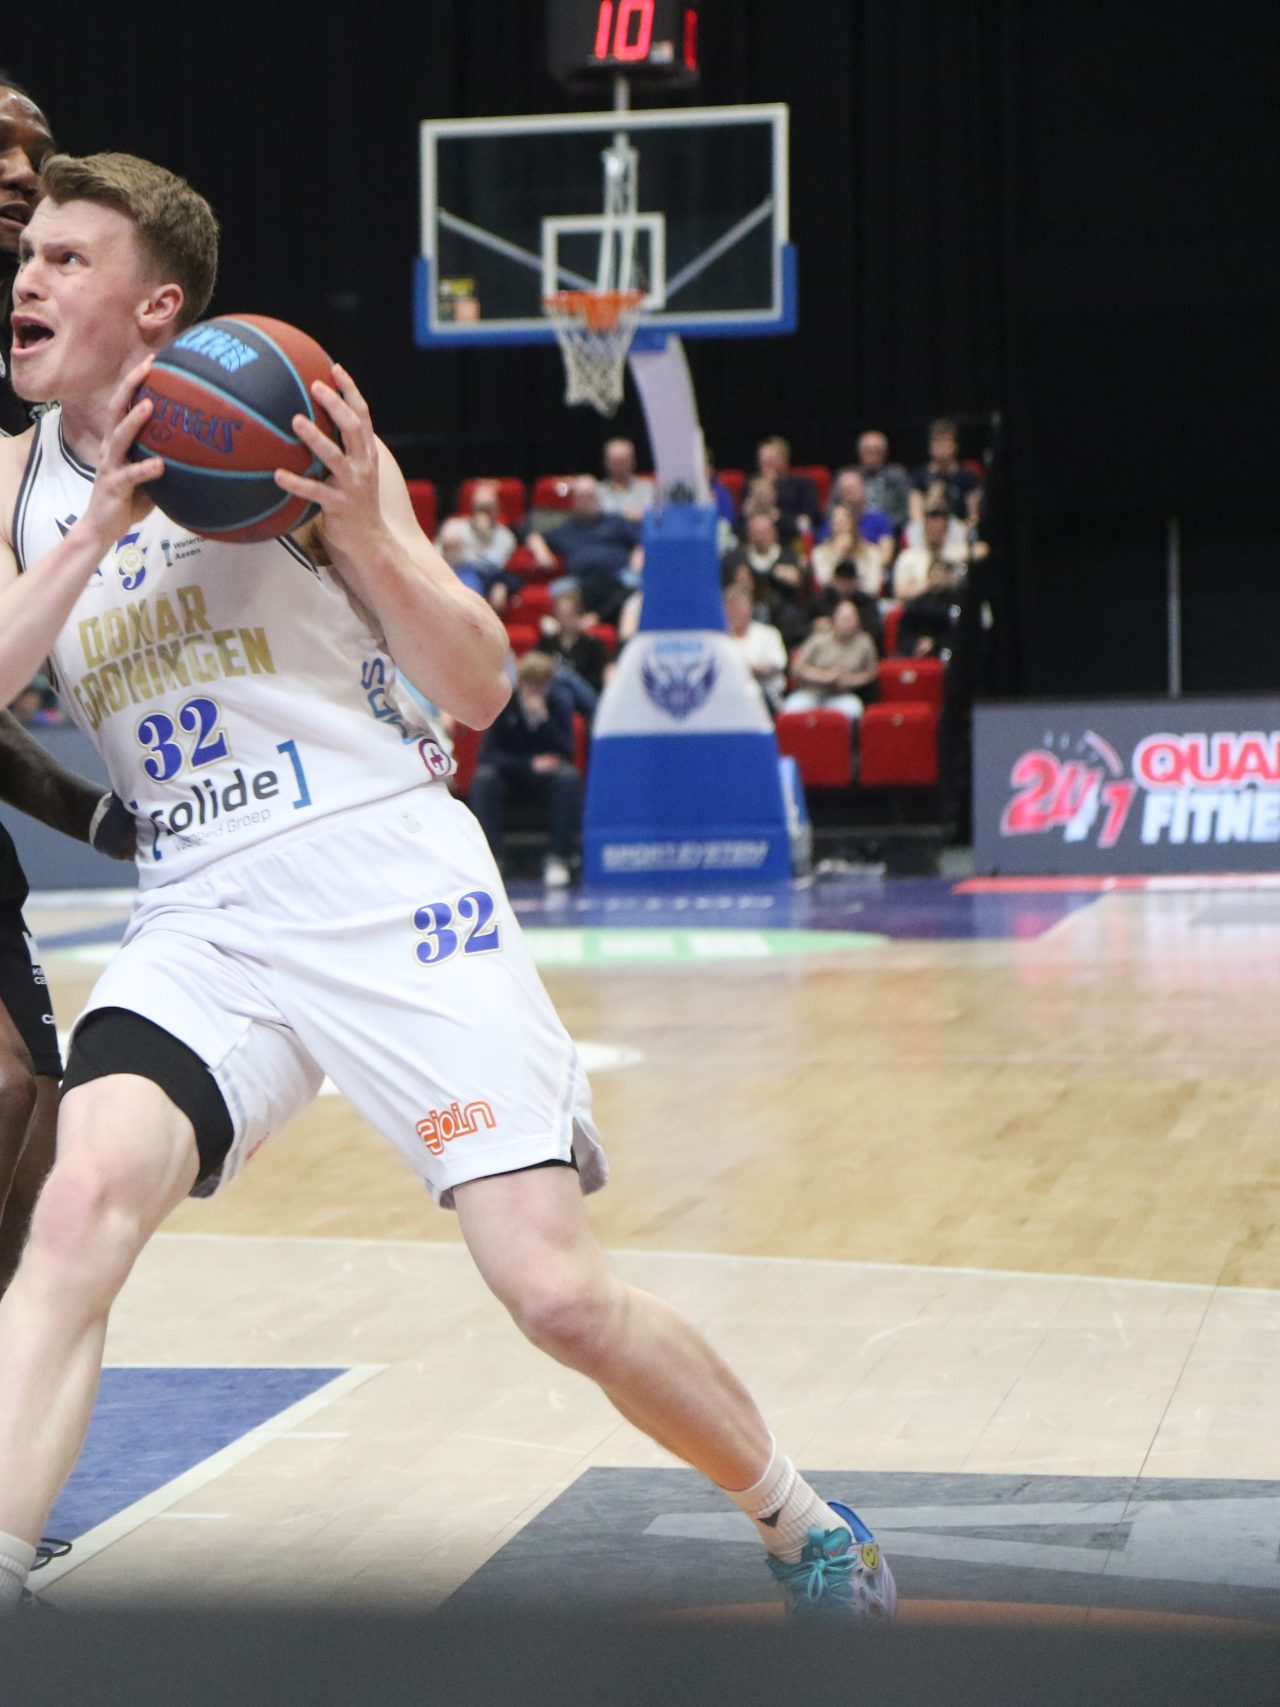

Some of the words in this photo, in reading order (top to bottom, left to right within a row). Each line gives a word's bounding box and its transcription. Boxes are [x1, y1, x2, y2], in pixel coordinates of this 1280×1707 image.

[594, 0, 655, 61] 10
[78, 584, 213, 669] DONAR
[135, 695, 233, 785] 32
[1131, 731, 1280, 792] QUA
[411, 888, 501, 966] 32
